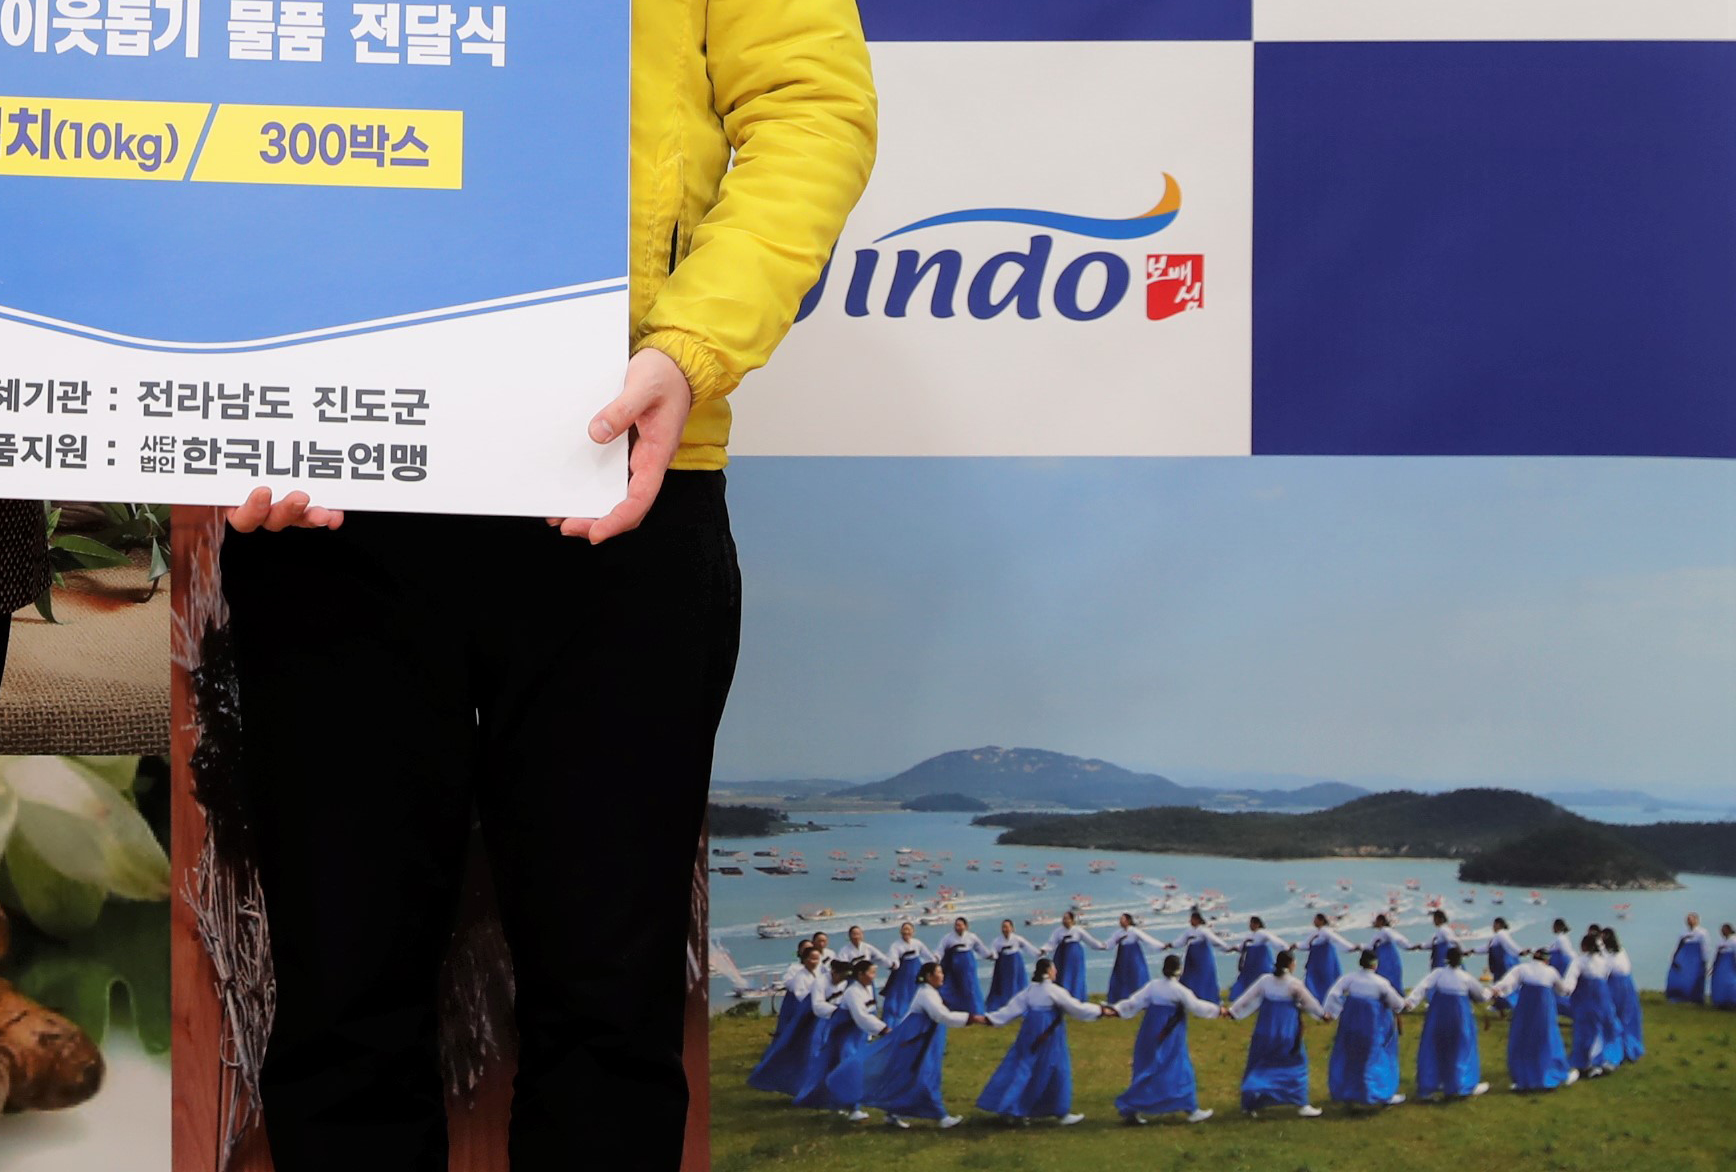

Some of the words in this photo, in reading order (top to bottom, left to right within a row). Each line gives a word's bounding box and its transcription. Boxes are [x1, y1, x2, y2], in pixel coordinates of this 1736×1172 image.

[227, 0, 326, 62] 물품
[349, 3, 506, 67] 전달식
[259, 121, 430, 168] 300박스
[137, 380, 294, 420] 전라남도
[312, 385, 430, 426] 진도군
[140, 435, 177, 454] 사단
[140, 455, 176, 474] 법인
[182, 436, 429, 482] 한국나눔연맹
